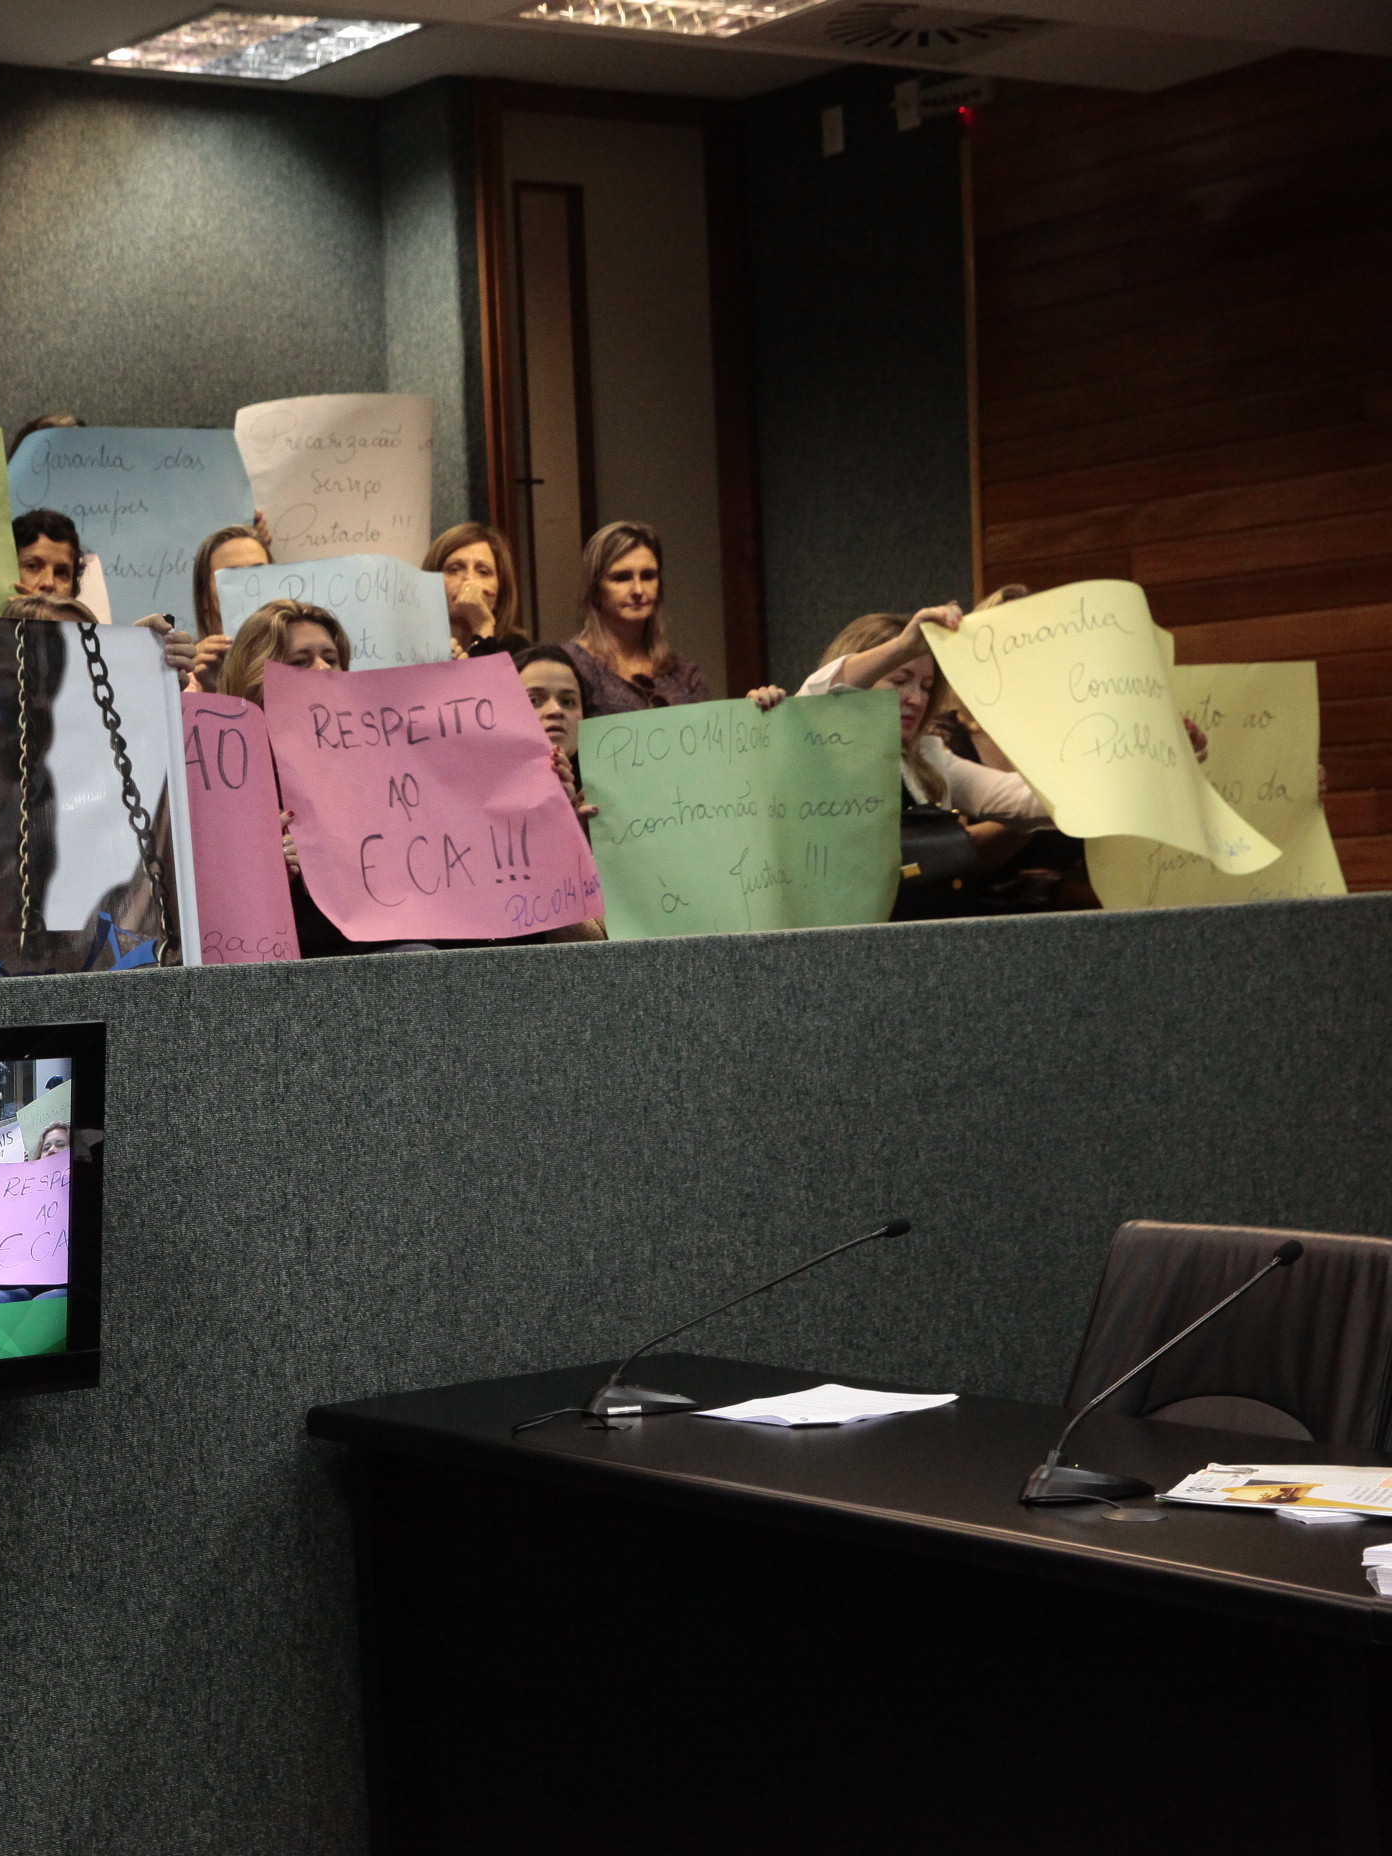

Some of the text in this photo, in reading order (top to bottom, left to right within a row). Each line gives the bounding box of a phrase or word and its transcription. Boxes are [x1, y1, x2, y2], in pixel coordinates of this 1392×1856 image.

[309, 696, 498, 749] RESPEITO
[183, 706, 250, 791] ÃO
[596, 725, 671, 773] PLC
[803, 727, 855, 746] na
[388, 772, 420, 822] AO
[2, 1167, 71, 1198] RESPE
